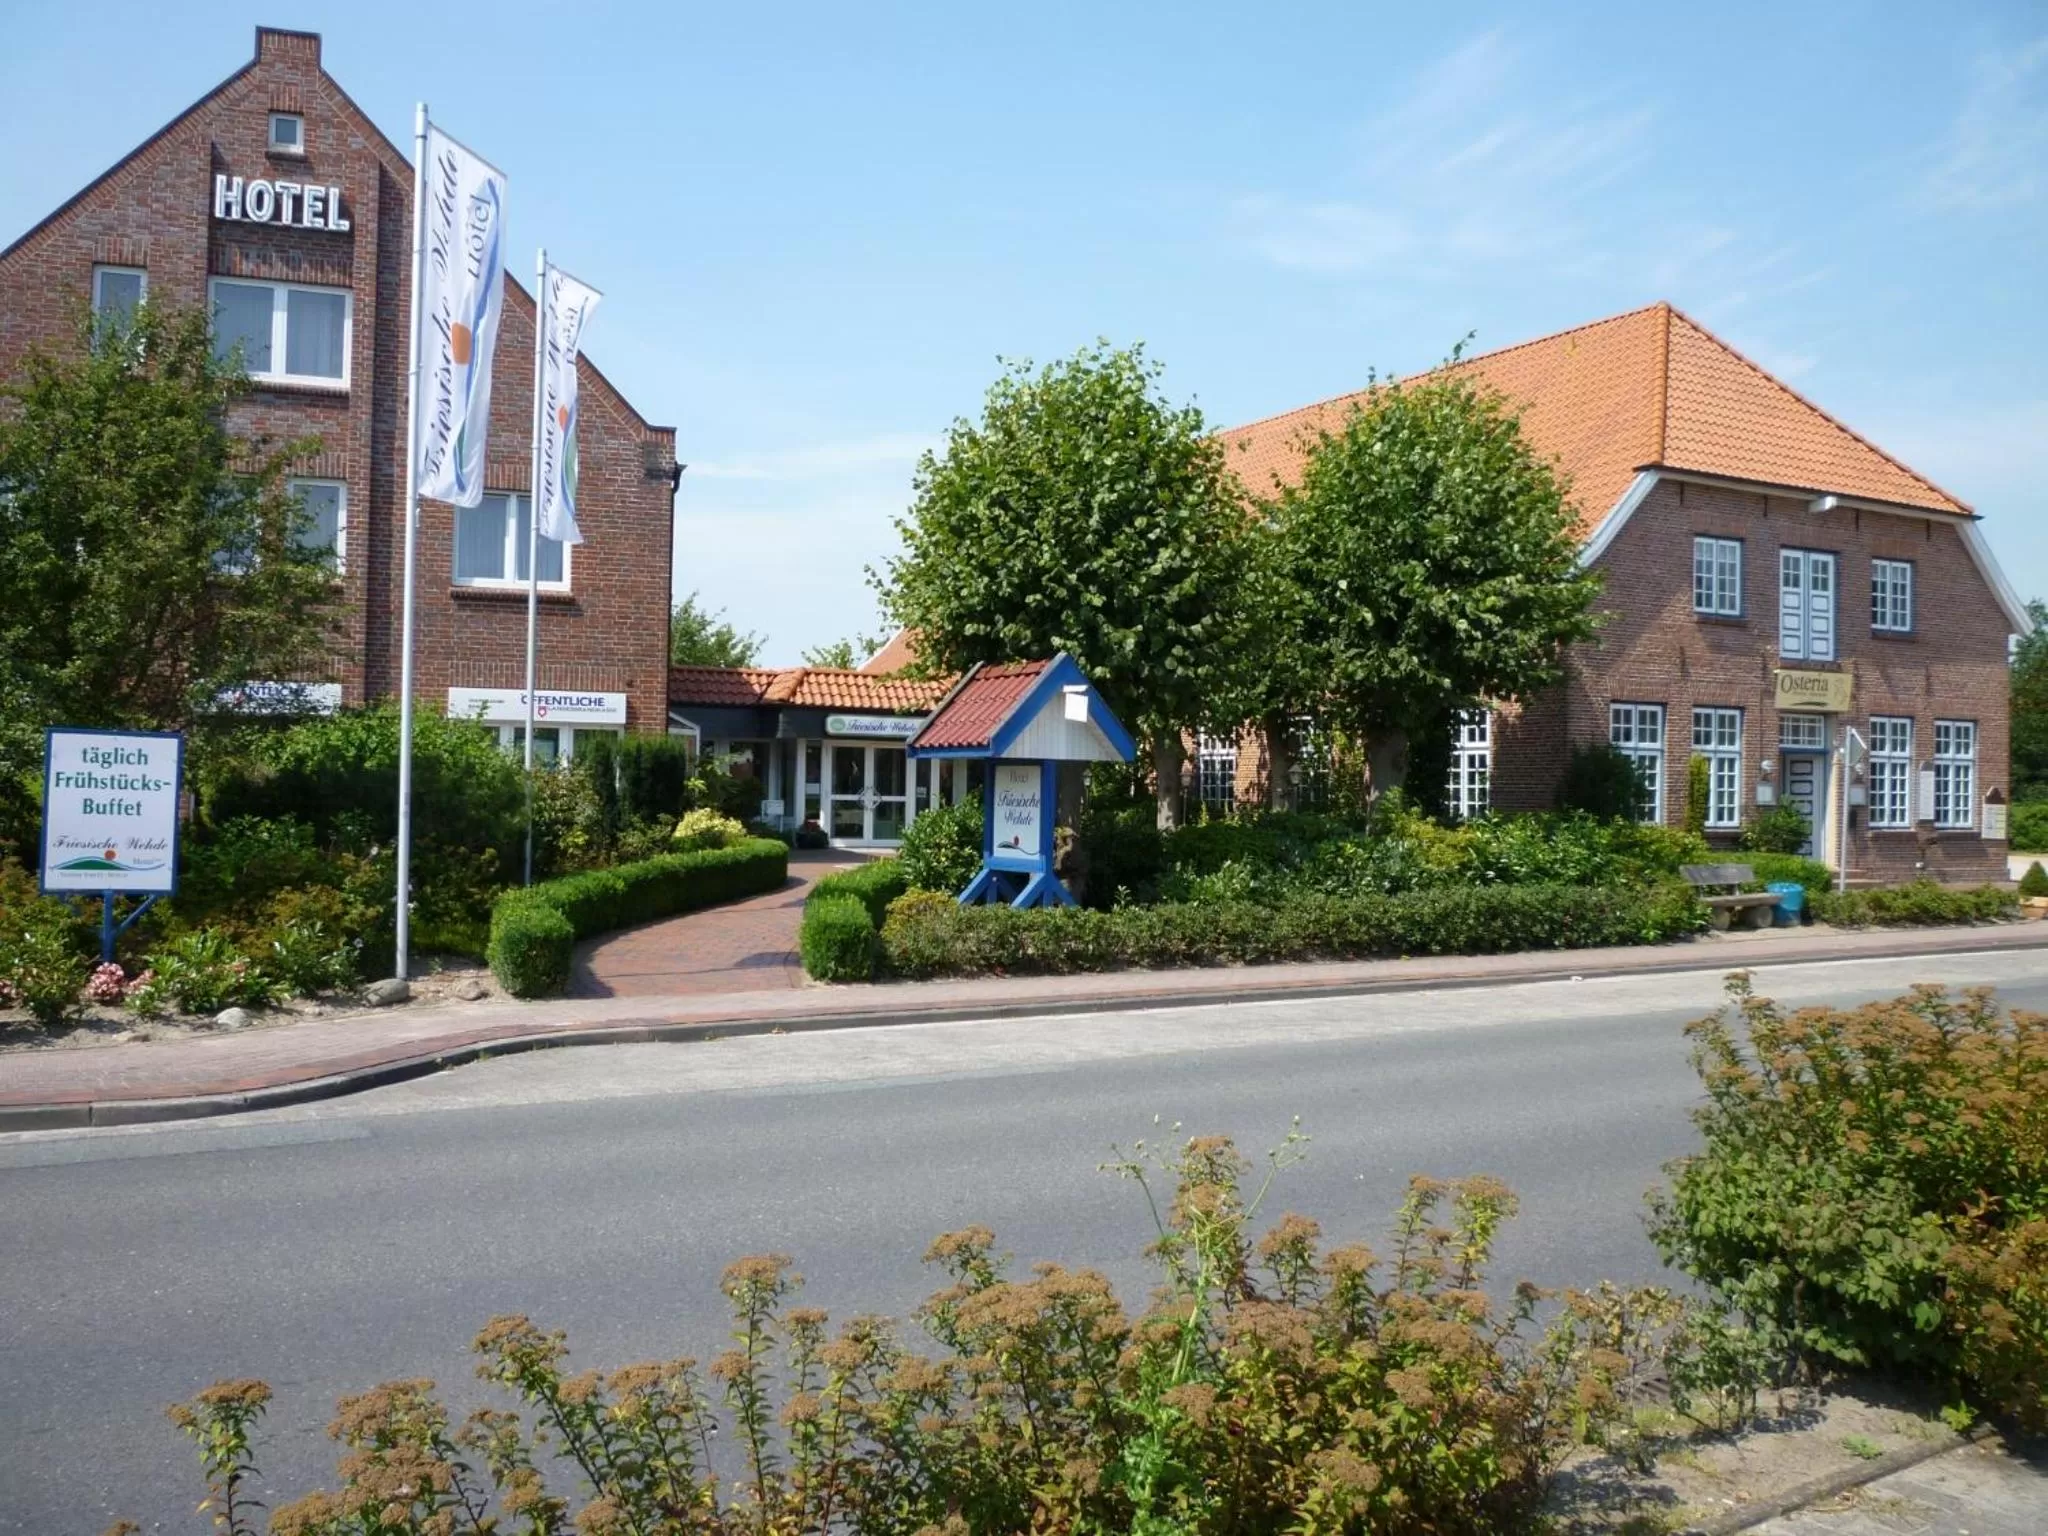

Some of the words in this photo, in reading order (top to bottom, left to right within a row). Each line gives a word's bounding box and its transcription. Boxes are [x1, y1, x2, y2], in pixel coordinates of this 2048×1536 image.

[214, 173, 350, 232] HOTEL
[1780, 672, 1829, 694] Osteria
[82, 746, 149, 769] täglich
[55, 771, 172, 791] Frühstücks-
[81, 797, 143, 816] Buffet
